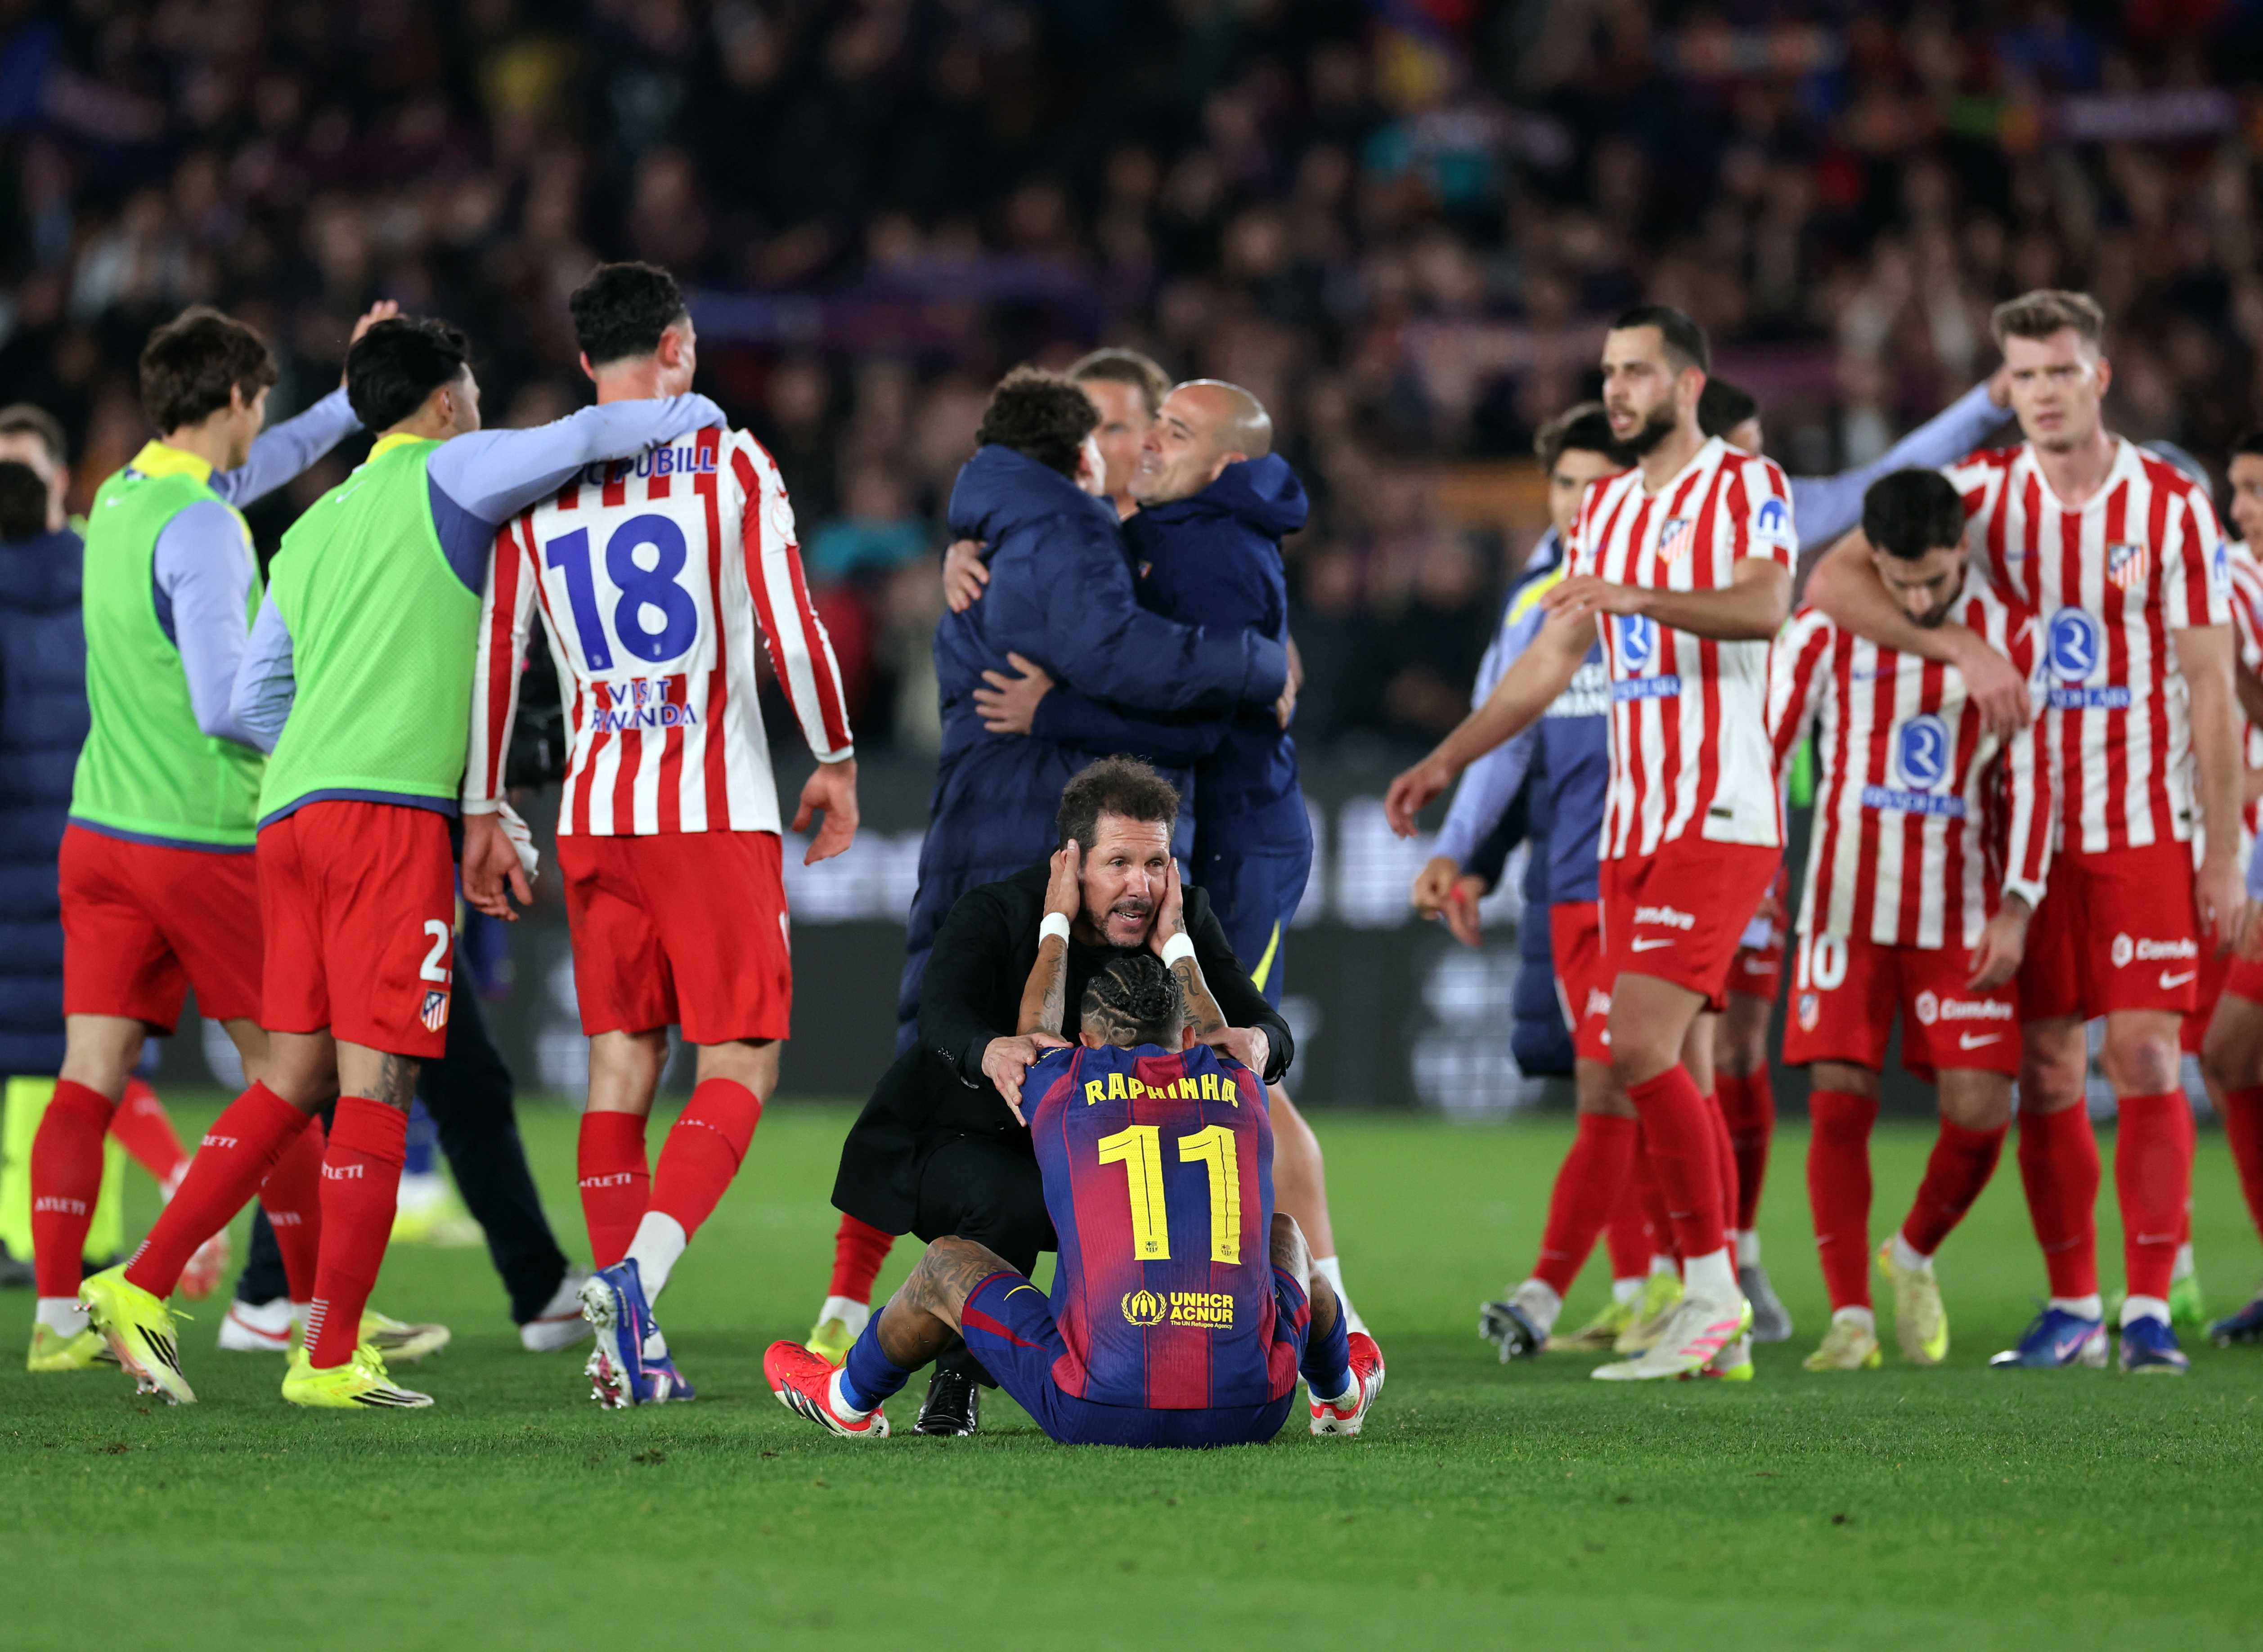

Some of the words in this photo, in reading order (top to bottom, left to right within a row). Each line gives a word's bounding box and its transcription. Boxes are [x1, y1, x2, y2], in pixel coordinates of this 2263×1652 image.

[546, 514, 698, 671] 18
[420, 918, 453, 984] 2
[1797, 933, 1848, 990] 10
[1085, 1073, 1239, 1108] RAPHINHA
[1098, 1124, 1242, 1265] 11
[1170, 1292, 1234, 1308] UNHCR
[1170, 1306, 1233, 1323] ACNUR
